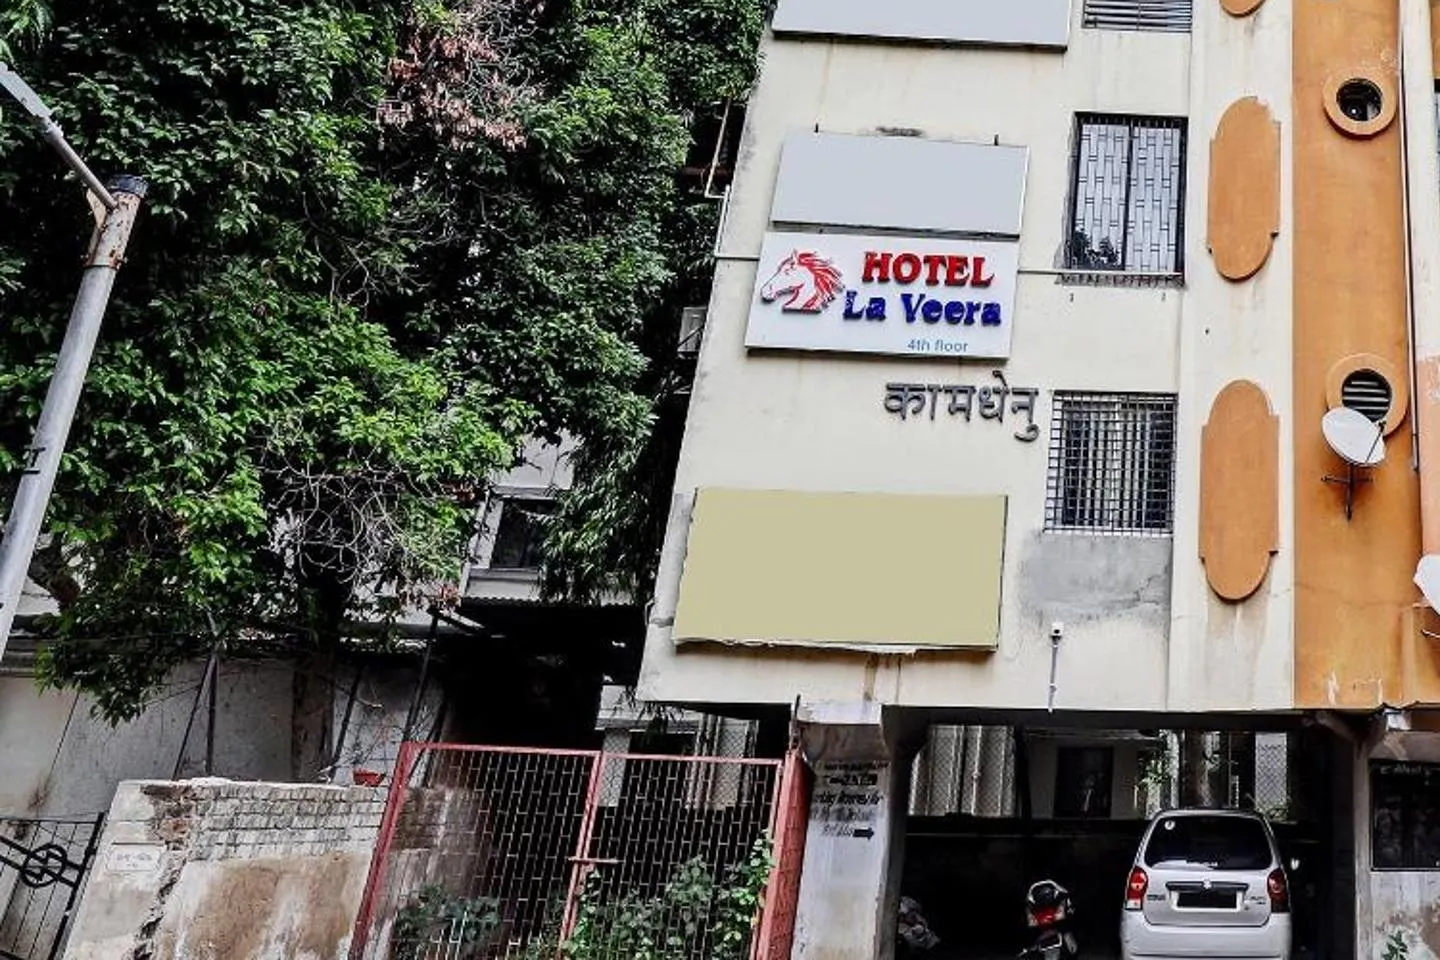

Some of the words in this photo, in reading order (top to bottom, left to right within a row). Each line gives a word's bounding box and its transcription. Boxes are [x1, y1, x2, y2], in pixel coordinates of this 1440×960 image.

[861, 251, 995, 288] HOTEL
[843, 291, 887, 321] La
[901, 293, 1002, 326] Veera
[907, 339, 931, 352] 4th
[934, 339, 969, 353] floor
[884, 371, 1039, 442] कामधेनु
